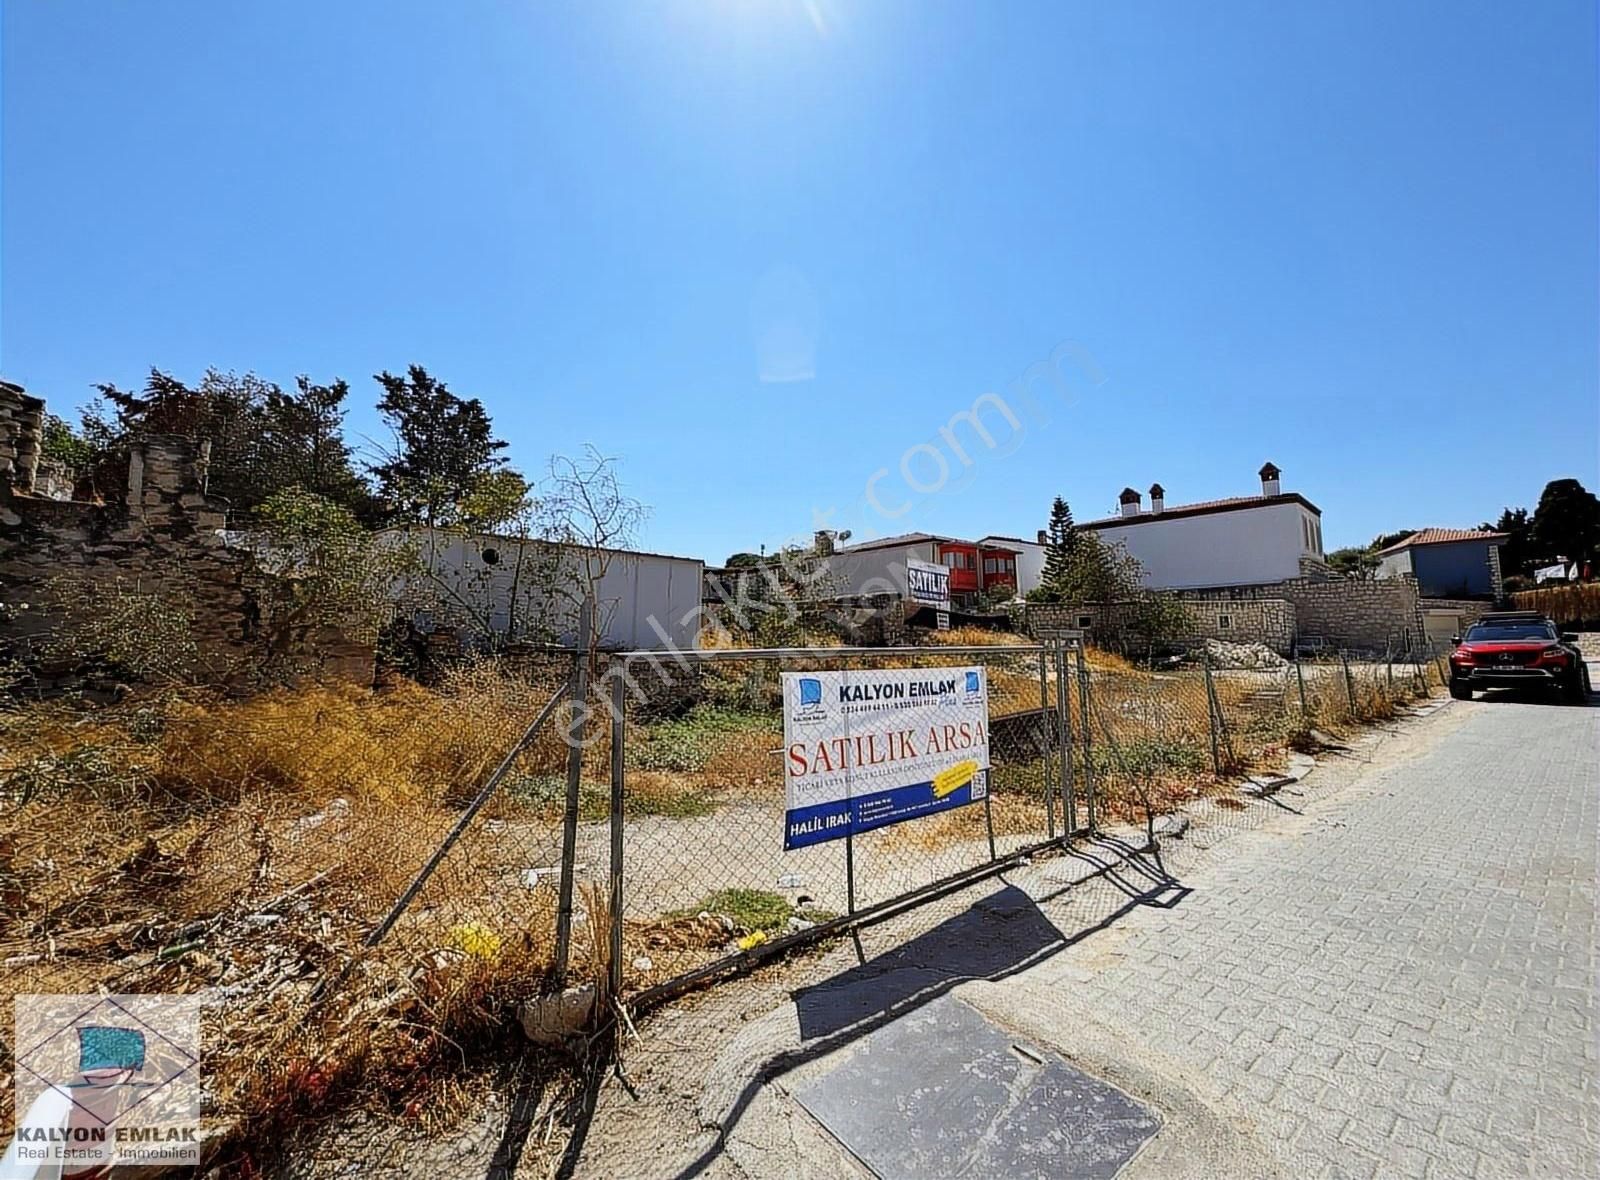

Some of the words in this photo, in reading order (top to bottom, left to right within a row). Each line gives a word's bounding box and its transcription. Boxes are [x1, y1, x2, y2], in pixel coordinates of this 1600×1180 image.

[908, 569, 948, 595] SATILIK
[839, 683, 904, 702] KALYON
[909, 680, 956, 696] EMLAK
[788, 728, 918, 777] SATILIK
[926, 720, 987, 755] ARSA
[790, 816, 825, 837] HALİL
[826, 811, 852, 830] IRAK
